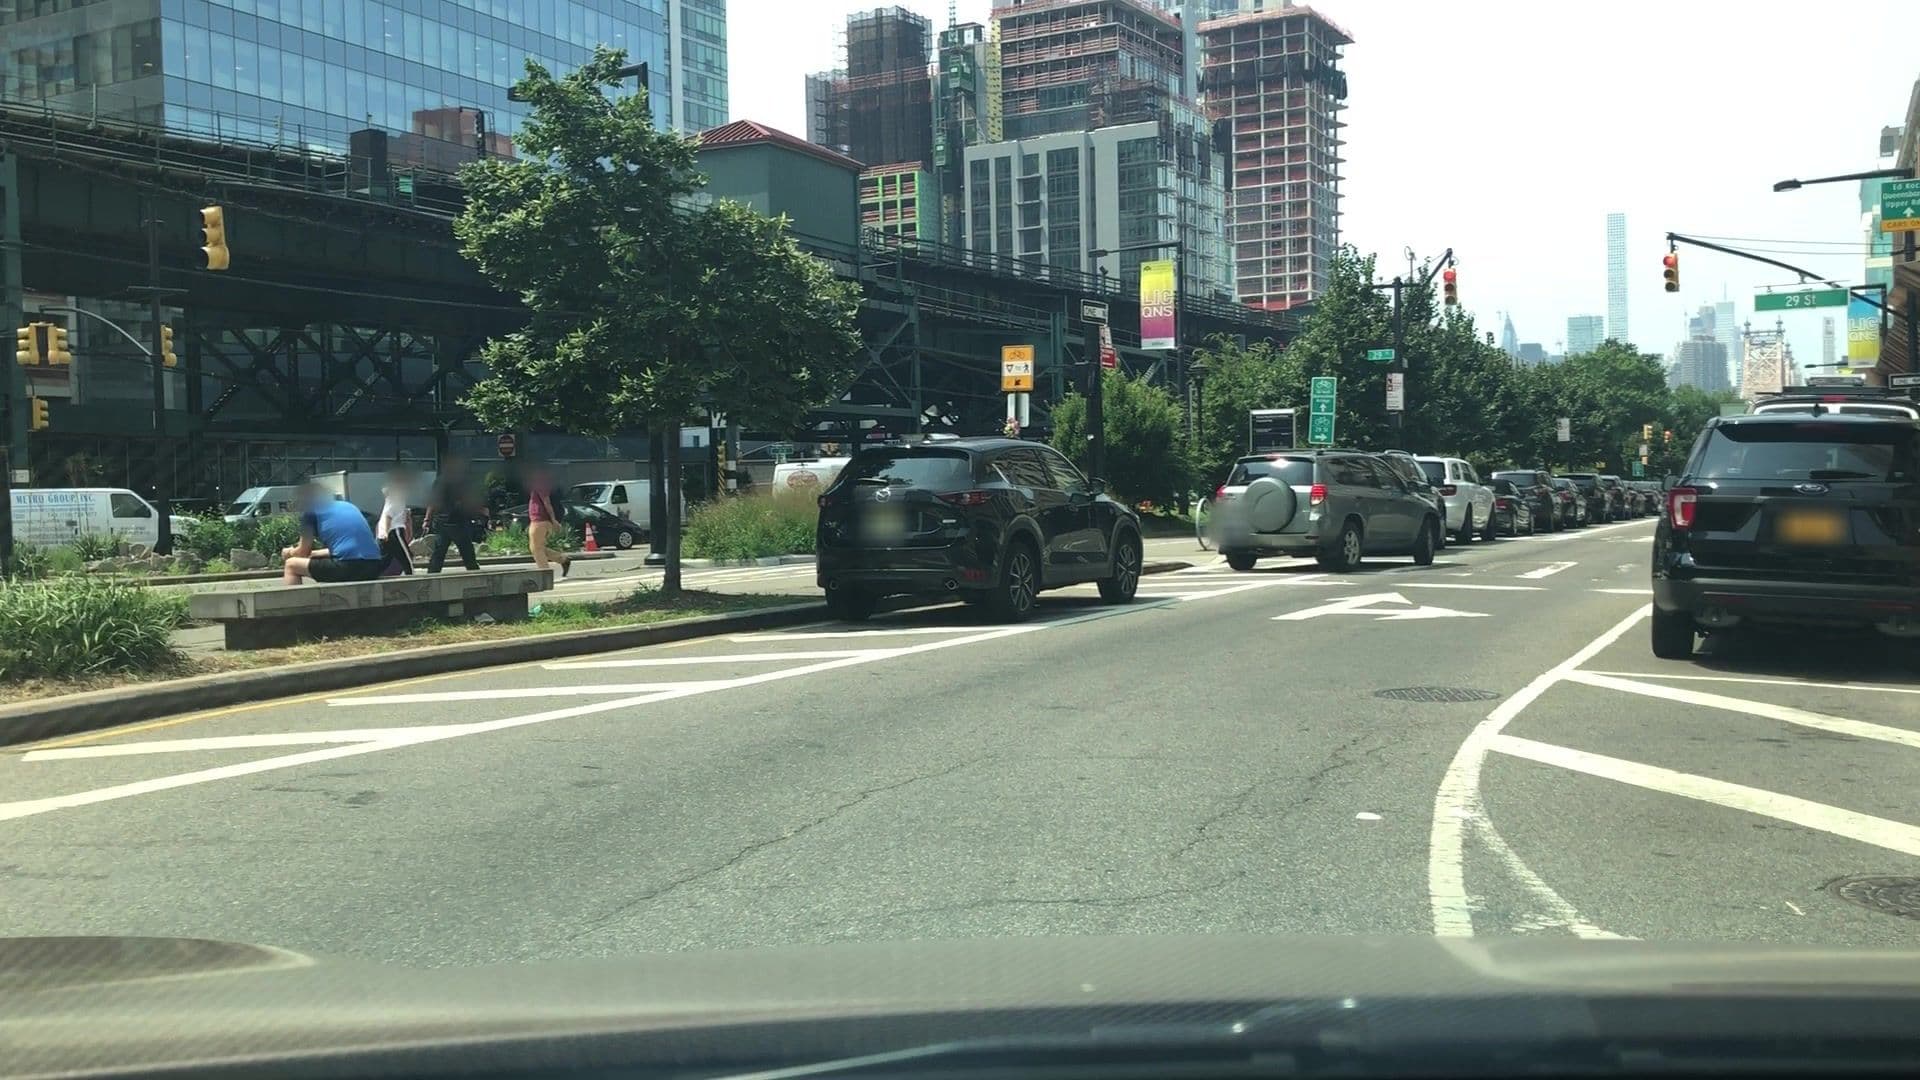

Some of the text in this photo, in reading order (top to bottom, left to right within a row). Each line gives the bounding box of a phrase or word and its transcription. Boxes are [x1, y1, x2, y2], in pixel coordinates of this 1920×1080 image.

[1143, 289, 1172, 306] LIC
[1785, 294, 1816, 307] 29 St
[1142, 306, 1173, 318] QNS
[16, 495, 44, 504] METRO
